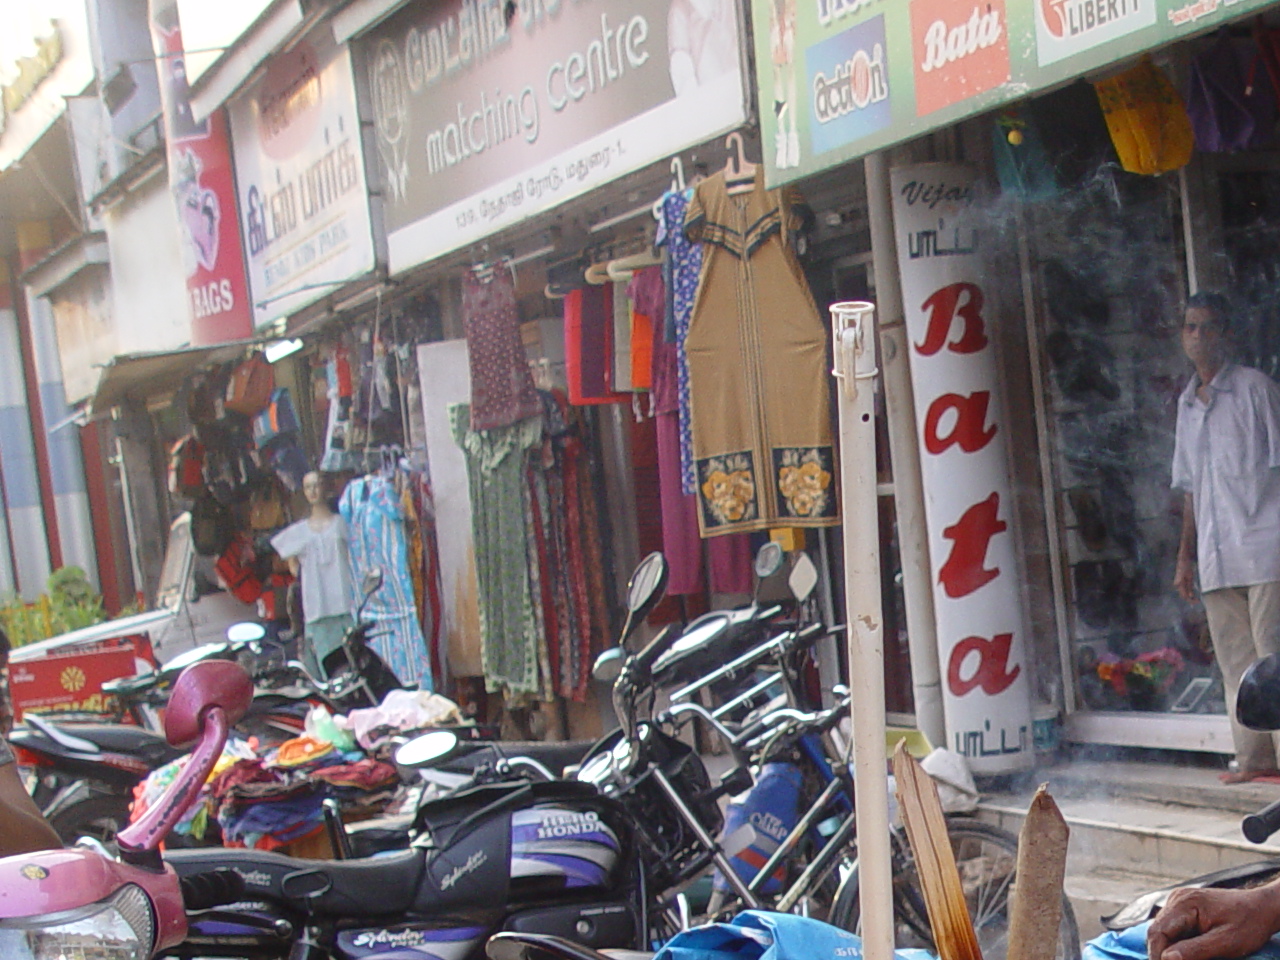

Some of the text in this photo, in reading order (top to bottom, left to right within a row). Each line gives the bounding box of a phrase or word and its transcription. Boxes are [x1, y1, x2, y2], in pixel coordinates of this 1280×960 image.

[922, 6, 1001, 72] Bata
[425, 84, 540, 175] matching
[547, 13, 650, 112] centre
[193, 278, 234, 319] BAGS
[538, 821, 605, 839] HONDA
[542, 811, 598, 828] HERO
